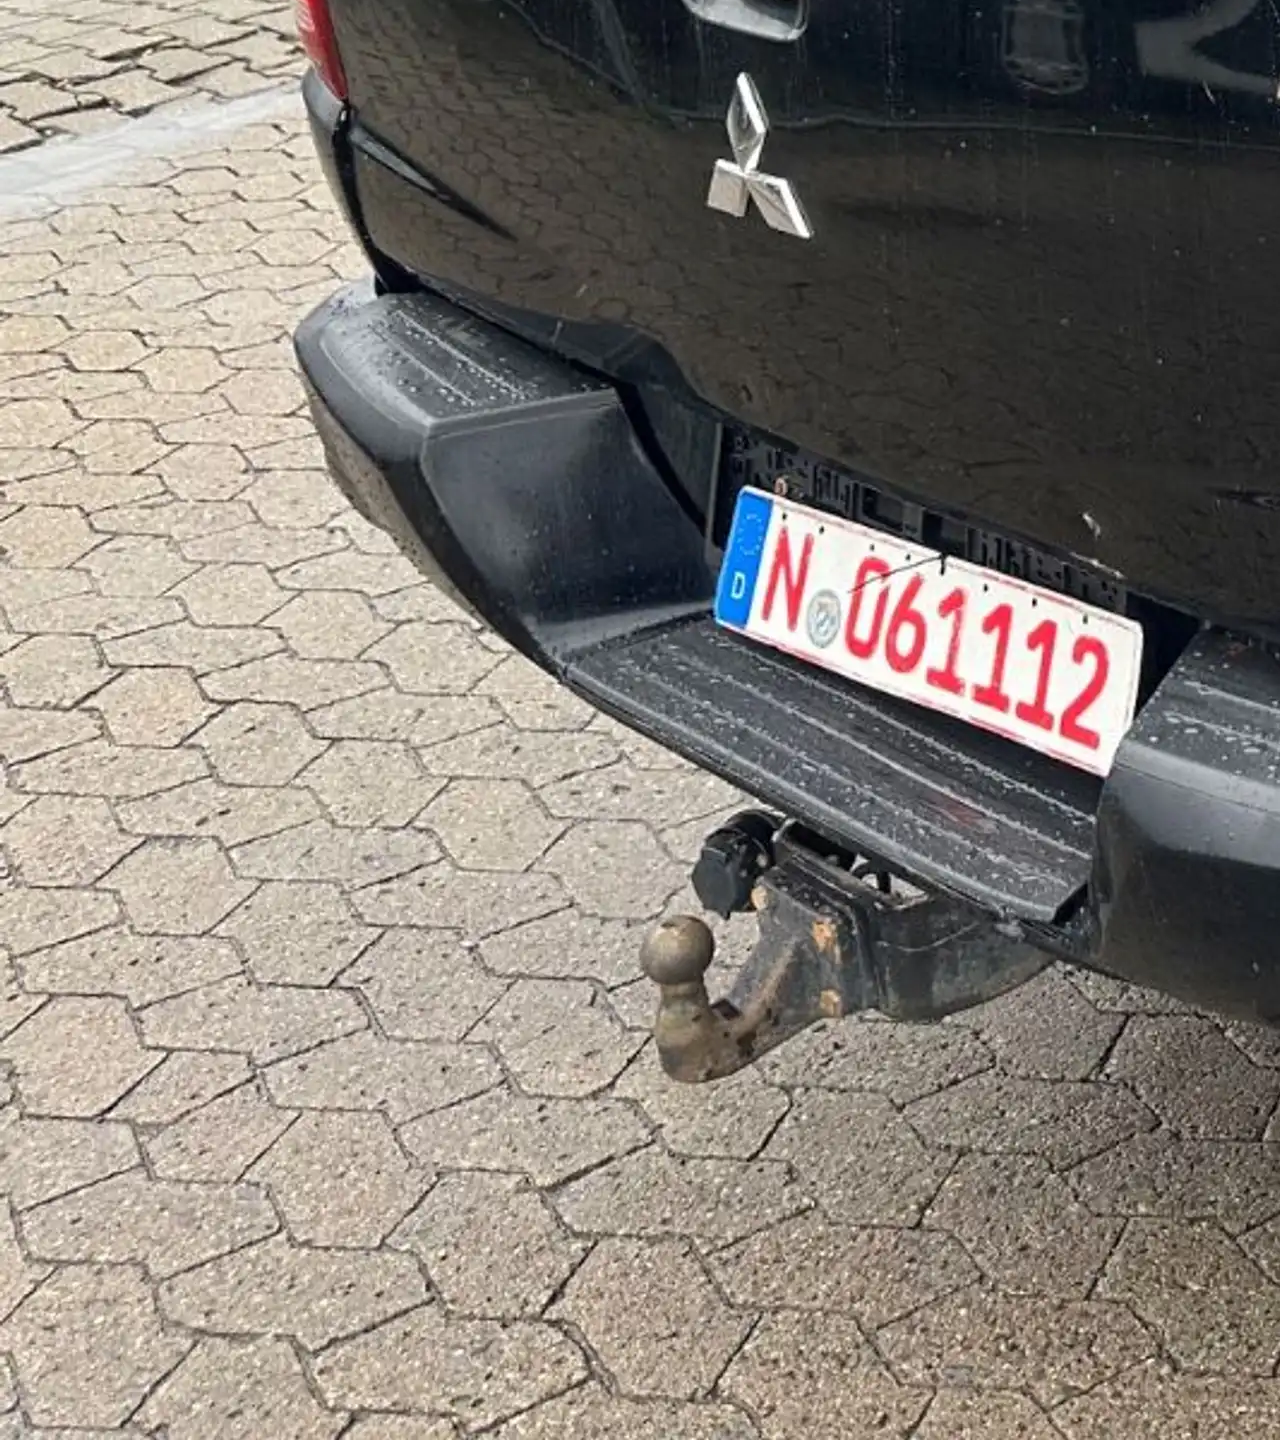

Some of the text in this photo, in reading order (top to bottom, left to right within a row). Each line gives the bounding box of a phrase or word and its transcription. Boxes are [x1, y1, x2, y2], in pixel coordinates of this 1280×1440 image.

[730, 572, 746, 601] D
[761, 524, 1110, 751] N 061112
